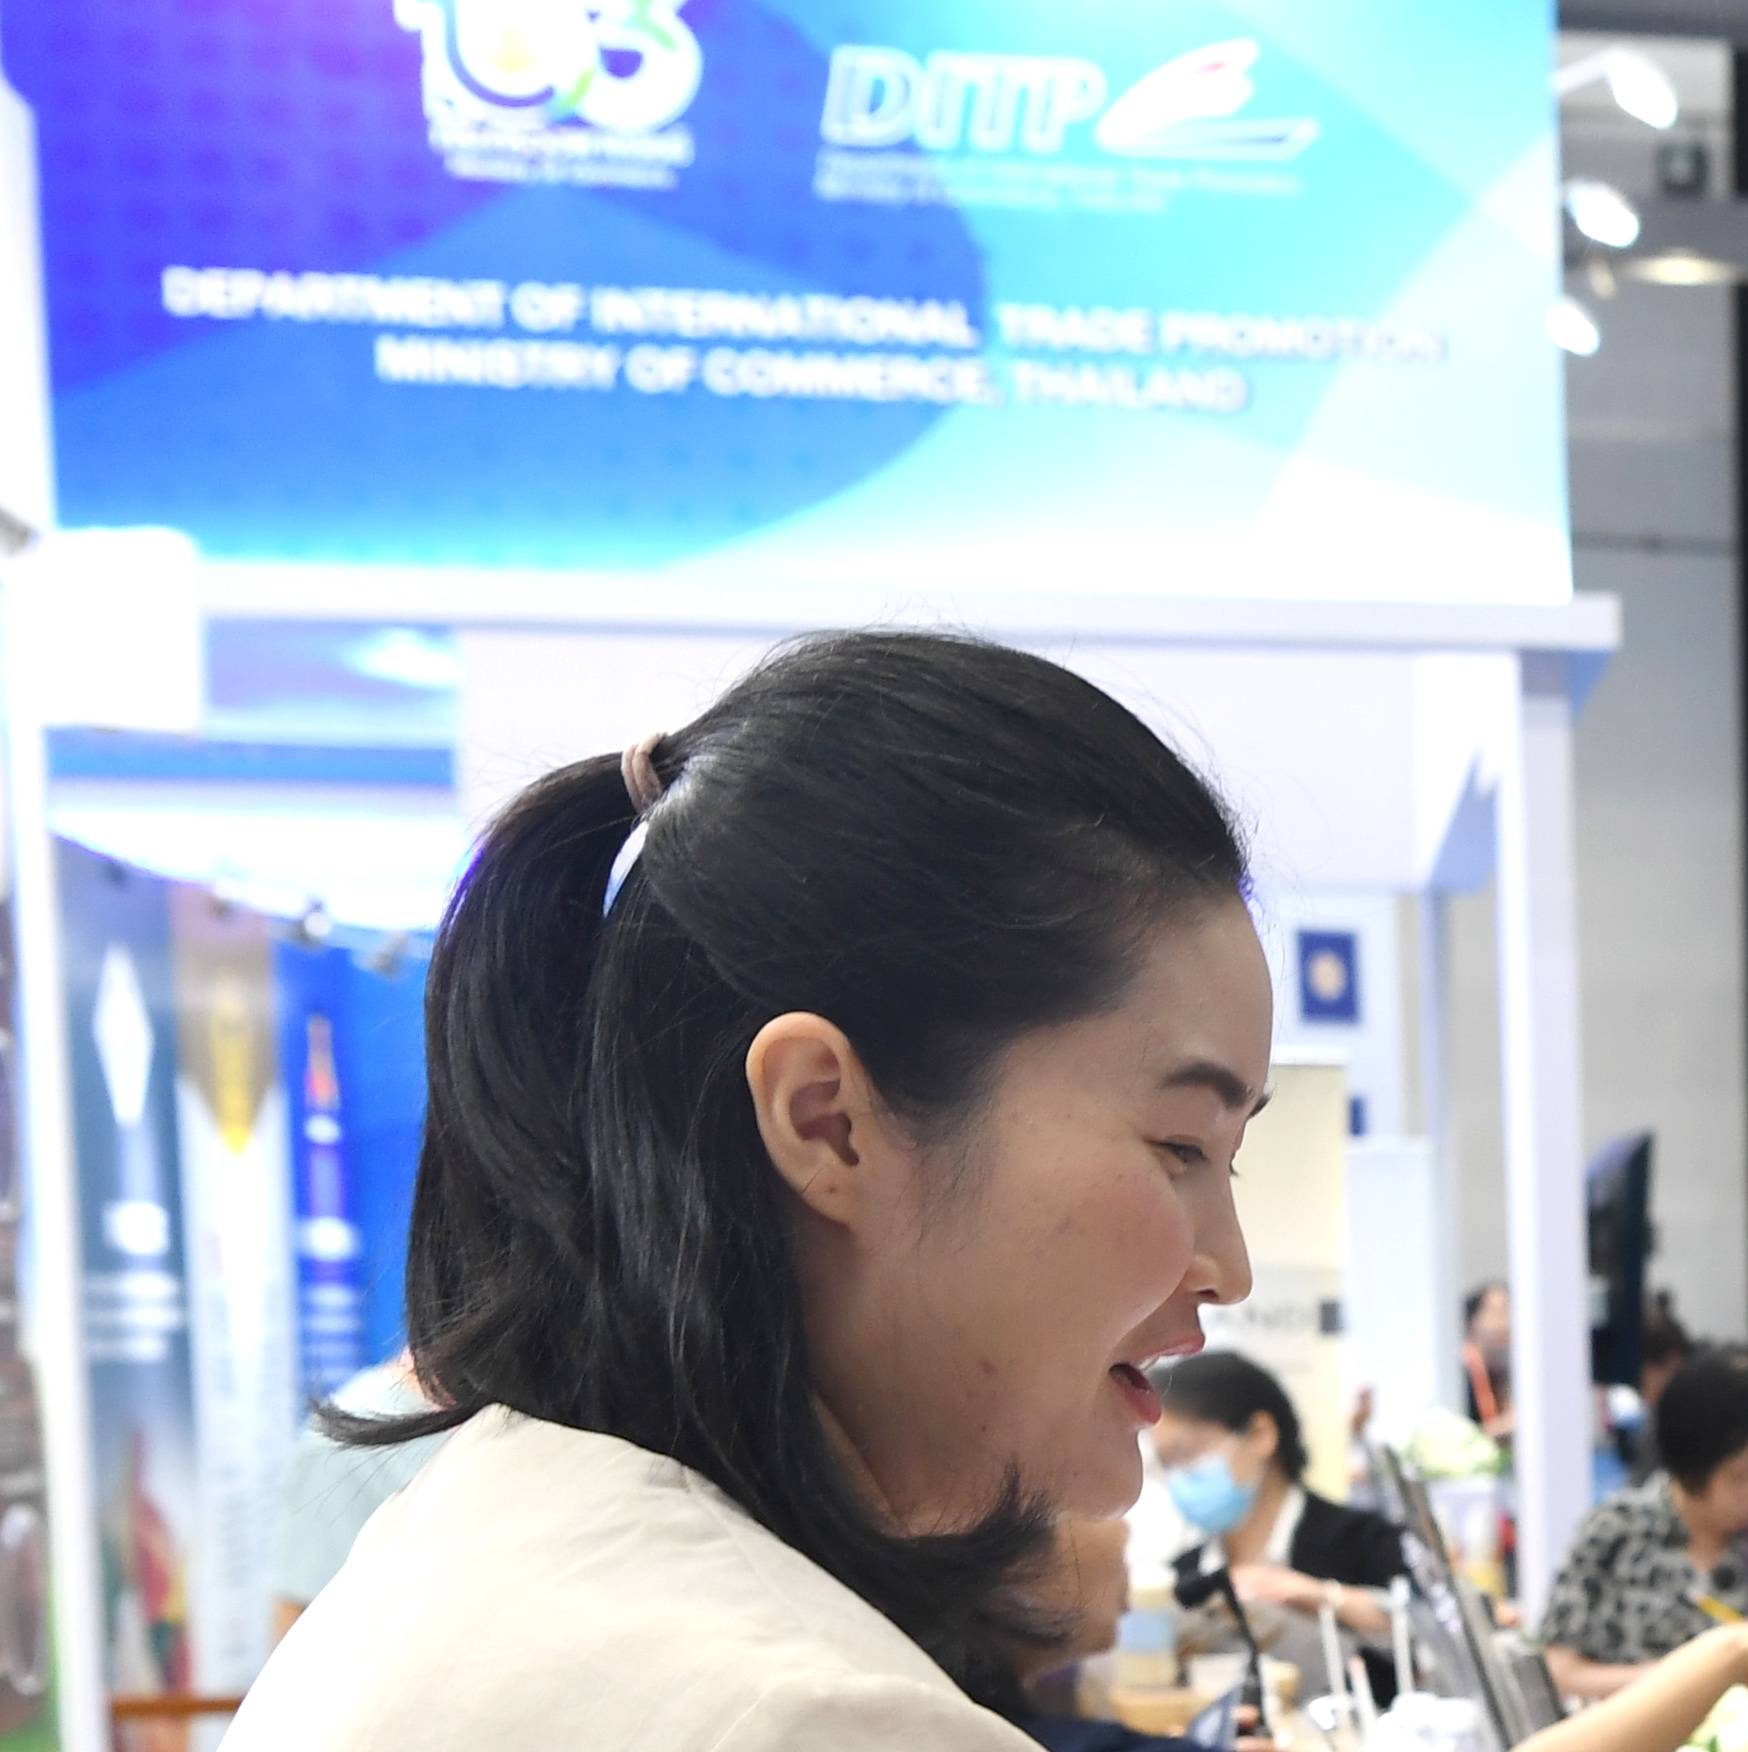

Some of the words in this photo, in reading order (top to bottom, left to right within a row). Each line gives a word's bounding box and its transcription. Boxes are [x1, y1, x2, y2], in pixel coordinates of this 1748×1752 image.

[161, 266, 506, 331] DEPARTMENT
[511, 284, 585, 334] OF
[592, 288, 980, 353] INTERNATIONAL
[996, 305, 1156, 356] TRADE
[1161, 313, 1447, 363] PROMOTION
[375, 336, 621, 392] MINISTRY
[625, 346, 697, 396] OF
[703, 350, 1002, 407] COMMERCE,
[1007, 367, 1253, 412] THAILAND
